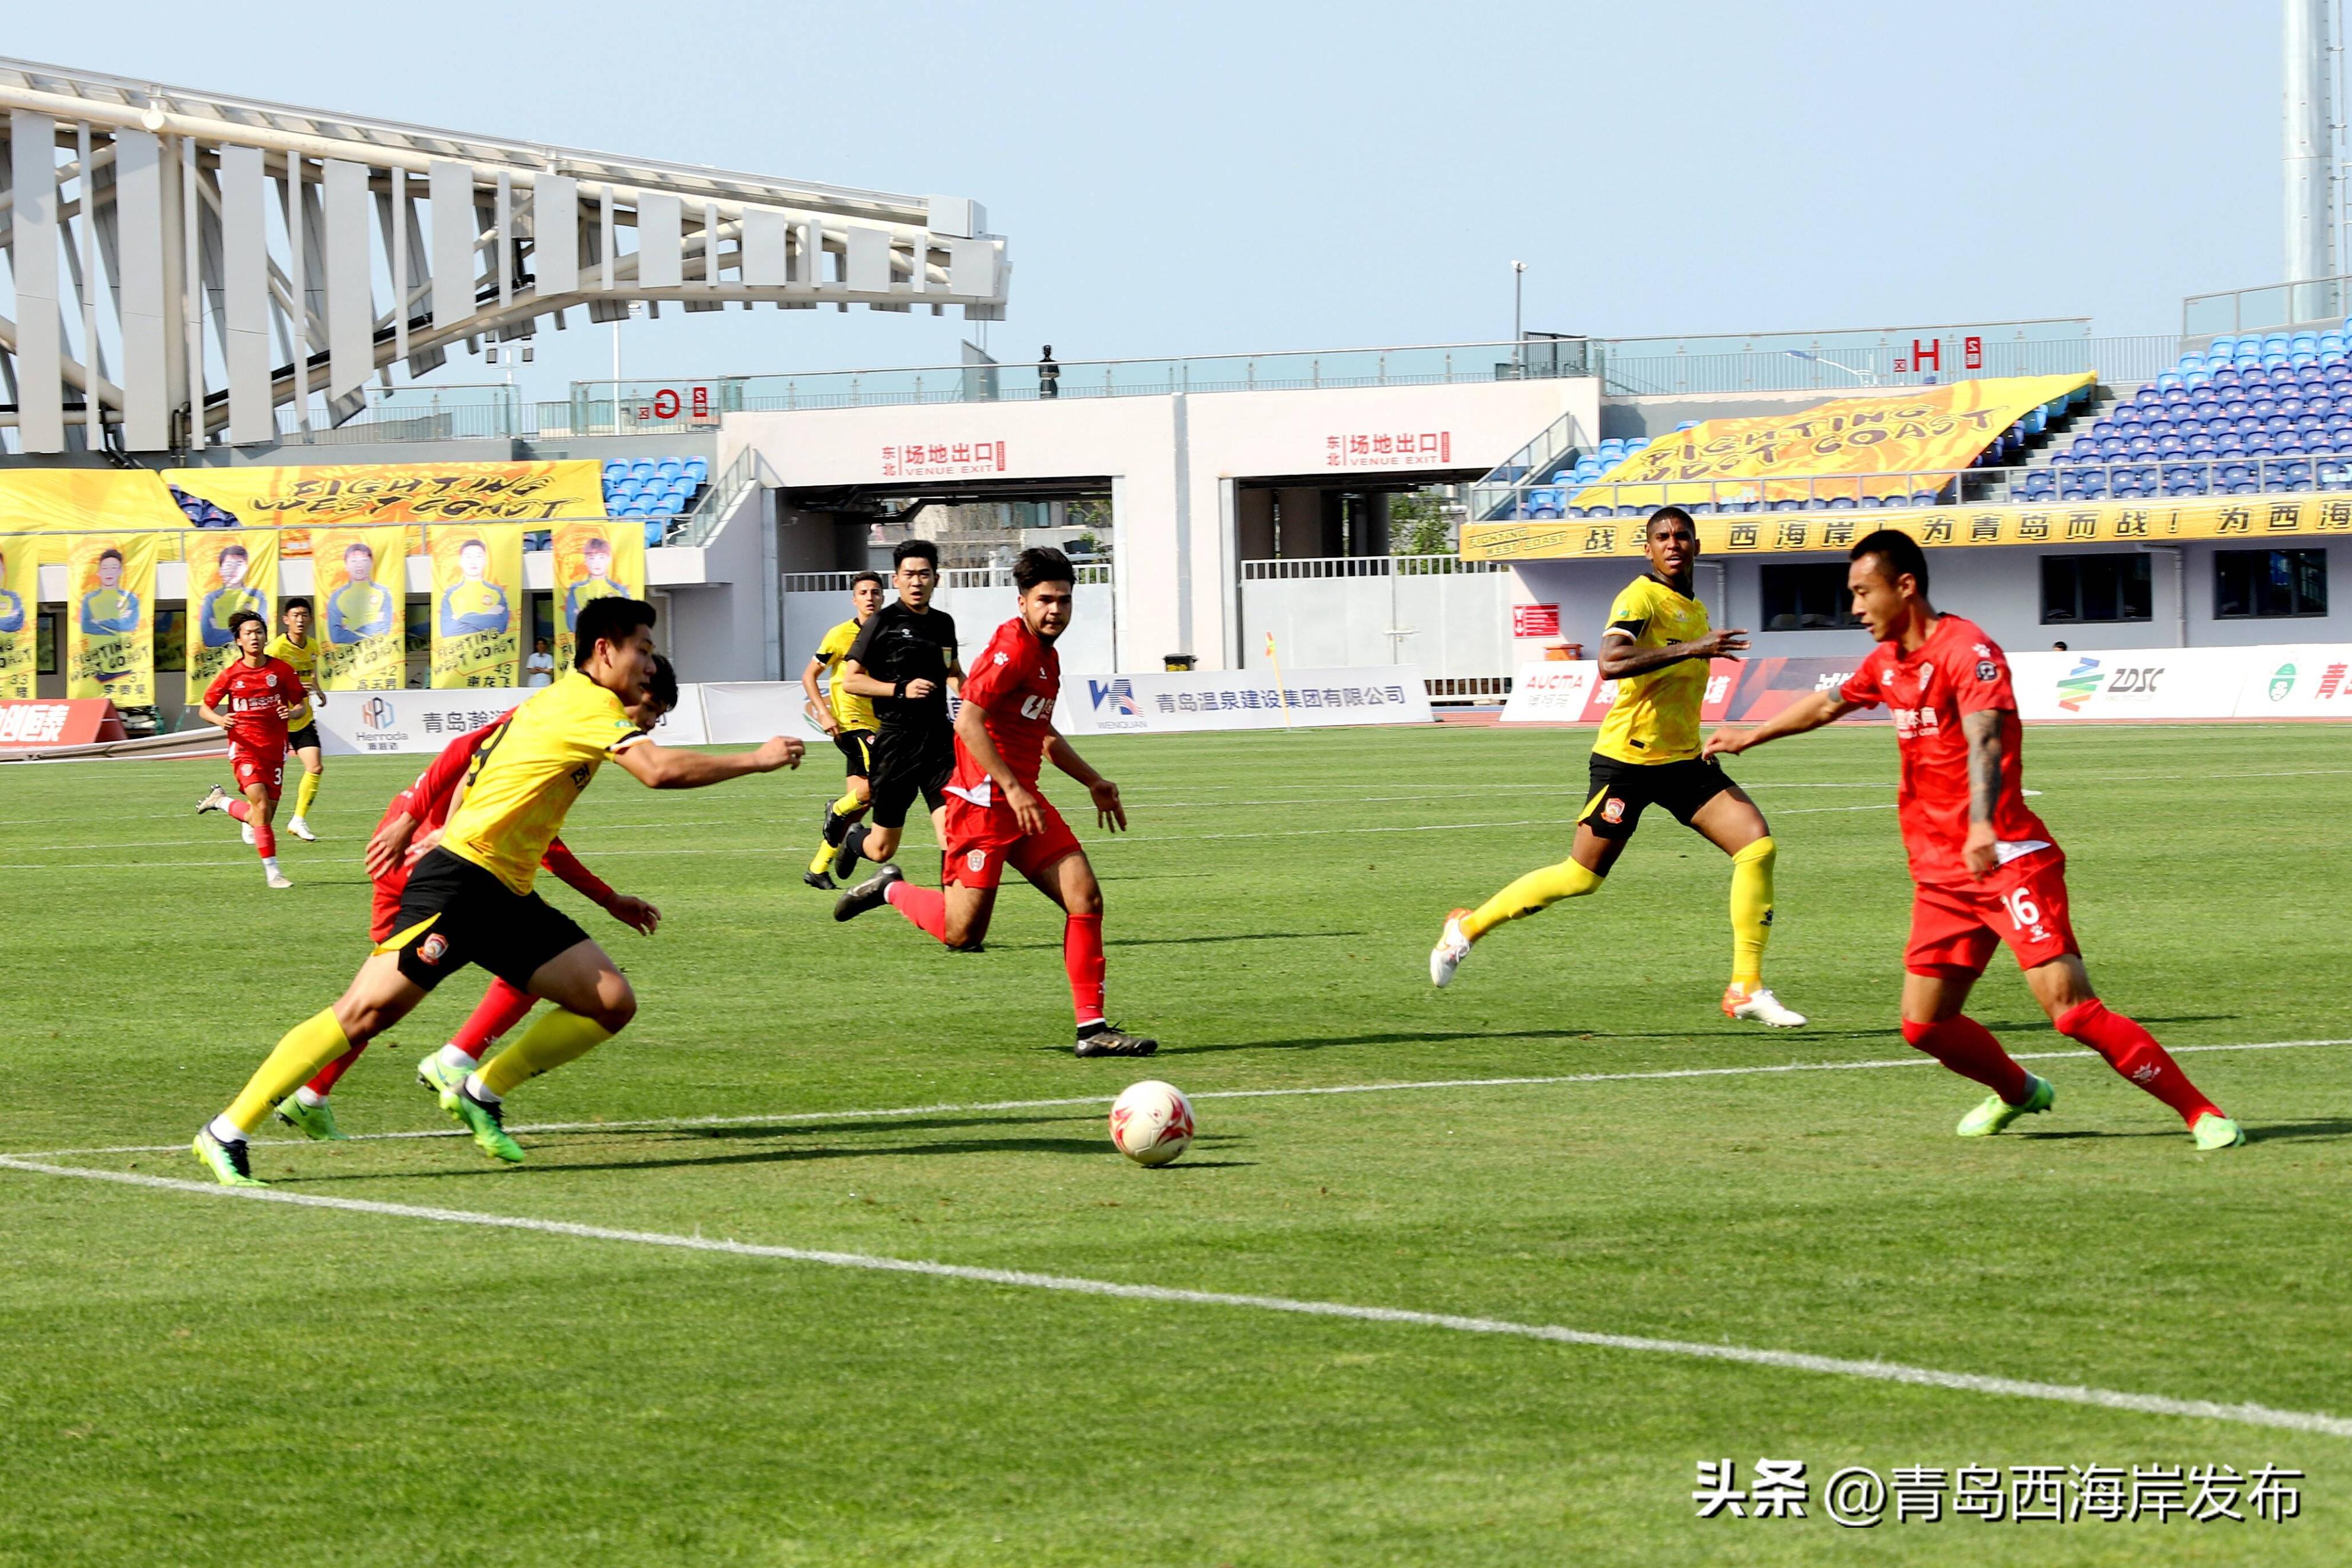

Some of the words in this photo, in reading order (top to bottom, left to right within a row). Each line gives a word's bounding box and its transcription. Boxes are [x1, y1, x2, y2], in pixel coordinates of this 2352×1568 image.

[1641, 405, 1937, 466] FIGHTING
[1808, 406, 2010, 454] COAST
[905, 443, 992, 464] 场地出口
[1350, 434, 1437, 454] 场地出口
[906, 467, 954, 475] VENUE
[961, 465, 993, 473] EXIT
[1350, 457, 1398, 466] VENUE
[1405, 455, 1437, 464] EXIT
[494, 664, 511, 674] 43
[1526, 675, 1583, 690] AUCMA
[2107, 668, 2165, 692] ZDSC
[1155, 686, 1406, 713] 青岛温泉建设集团有限公司
[355, 731, 408, 741] Herroda
[274, 768, 282, 785] 3
[2000, 887, 2039, 930] 16
